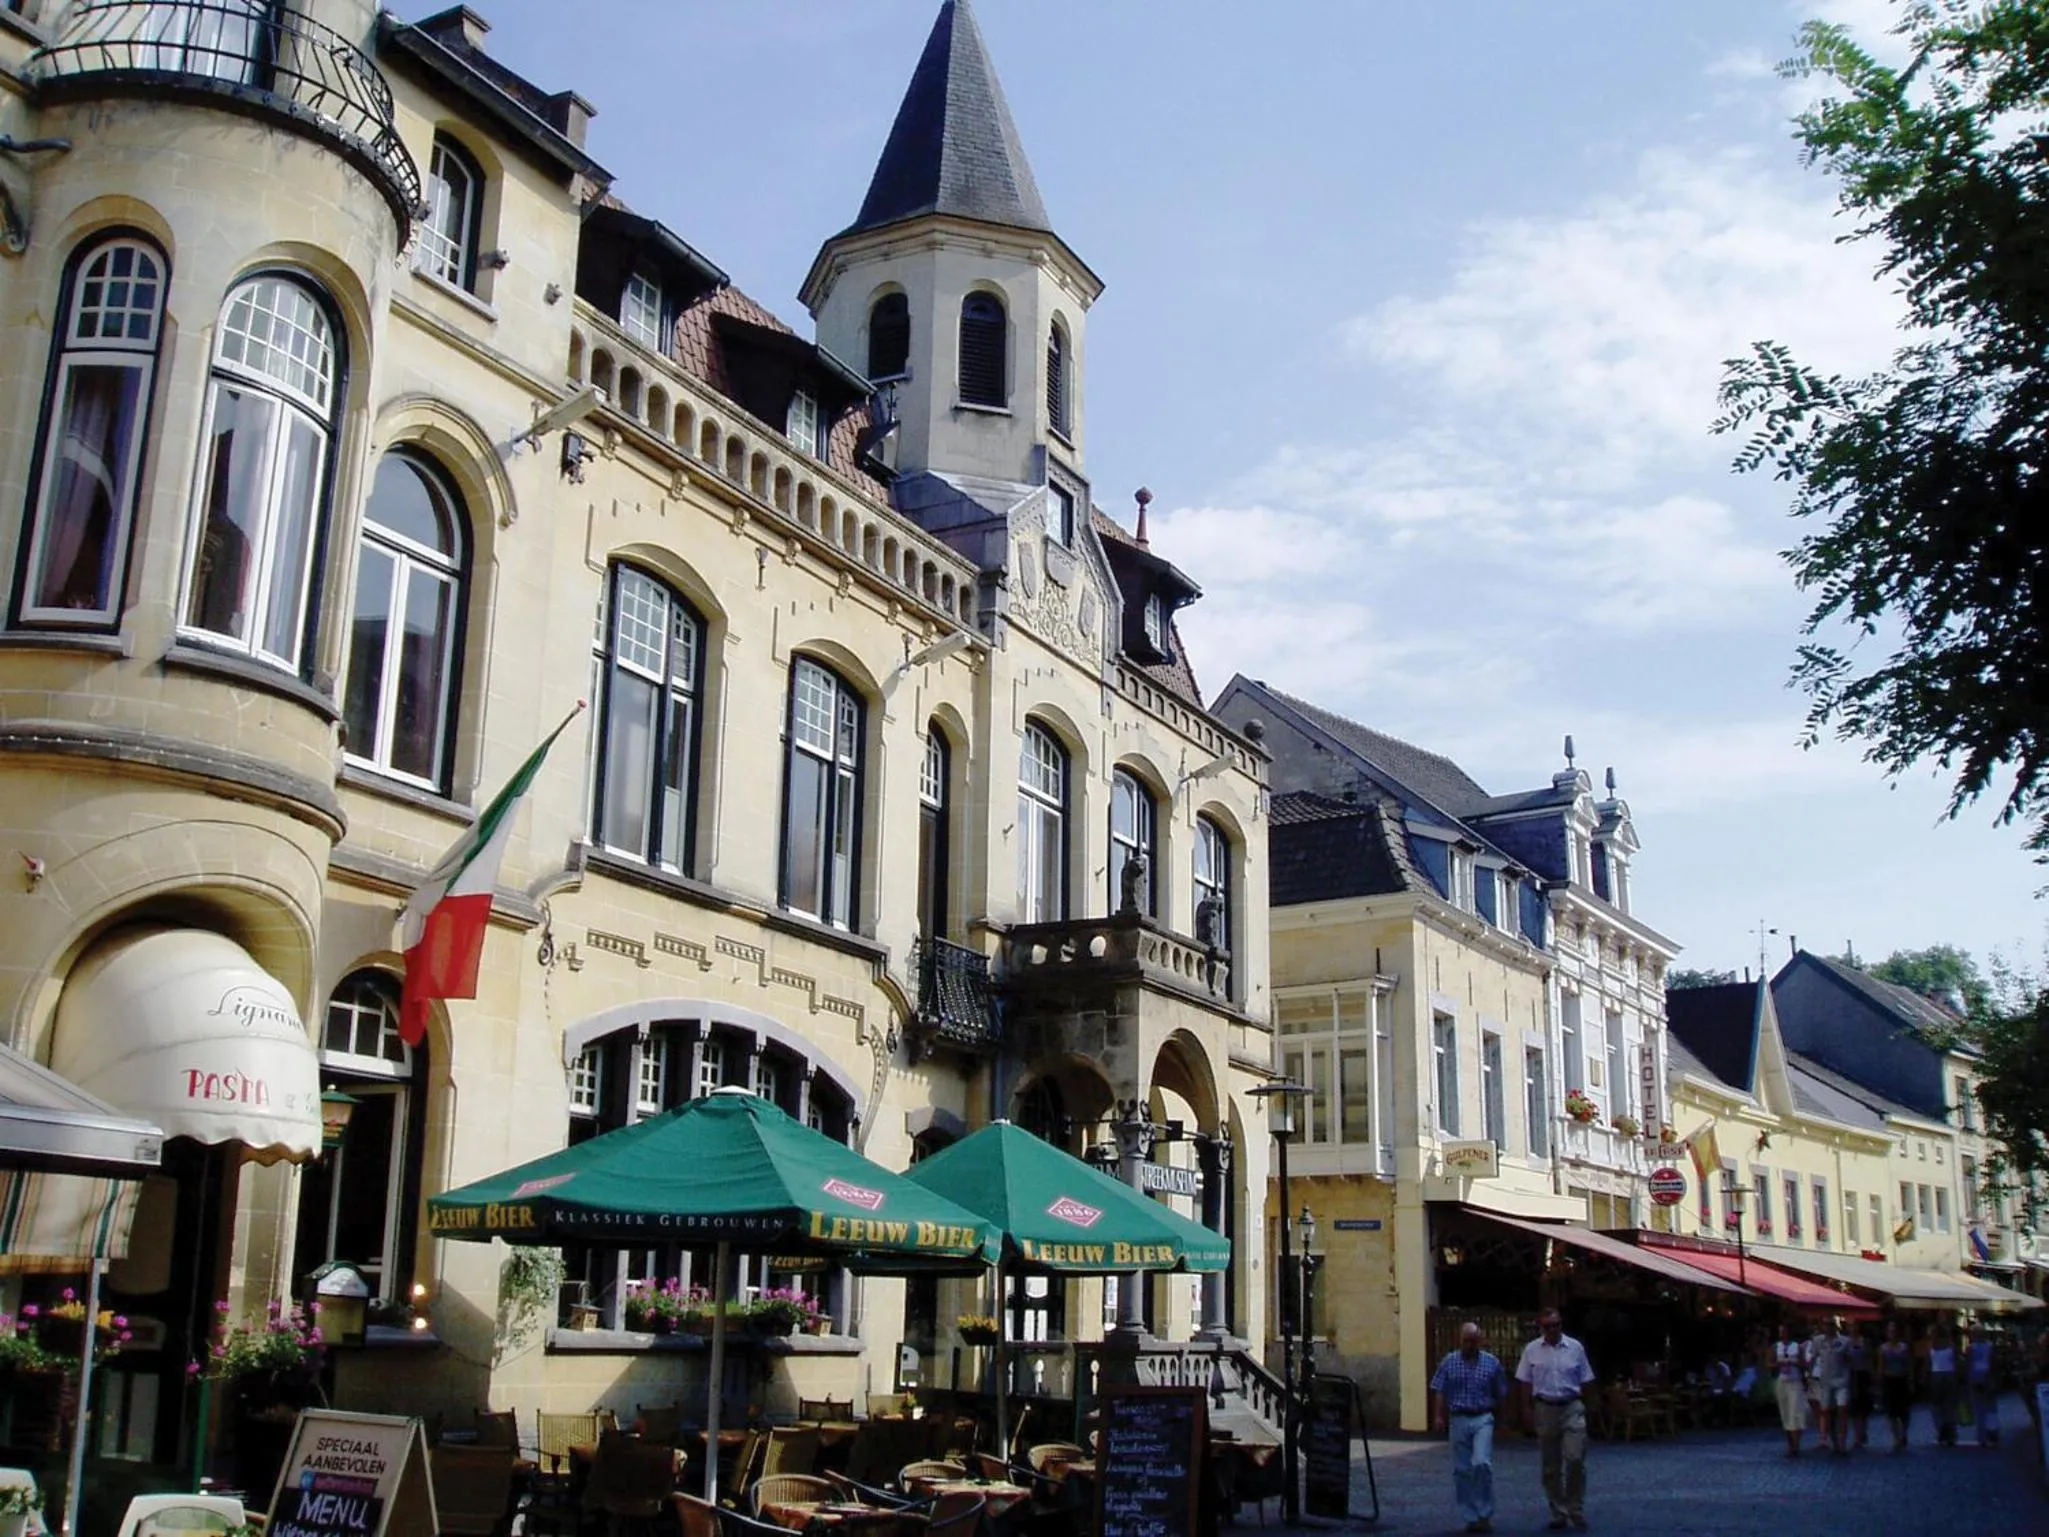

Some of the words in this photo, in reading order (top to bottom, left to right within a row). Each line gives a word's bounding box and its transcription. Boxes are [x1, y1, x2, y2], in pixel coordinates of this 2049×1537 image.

[180, 1067, 269, 1106] PASTA
[1640, 1047, 1657, 1139] HOTEL
[431, 1204, 479, 1229] LEEUW
[485, 1202, 536, 1228] BIER
[555, 1210, 646, 1225] KLASSIEK
[659, 1214, 784, 1229] GEBROUWEN
[809, 1210, 908, 1244] LEEUW
[916, 1220, 977, 1248] BIER
[1022, 1237, 1105, 1264] LEEUW
[1113, 1241, 1175, 1264] BIER
[316, 1437, 380, 1457] SPECIAAL
[301, 1453, 388, 1475] AANBEVOLEN
[297, 1490, 368, 1530] MENU
